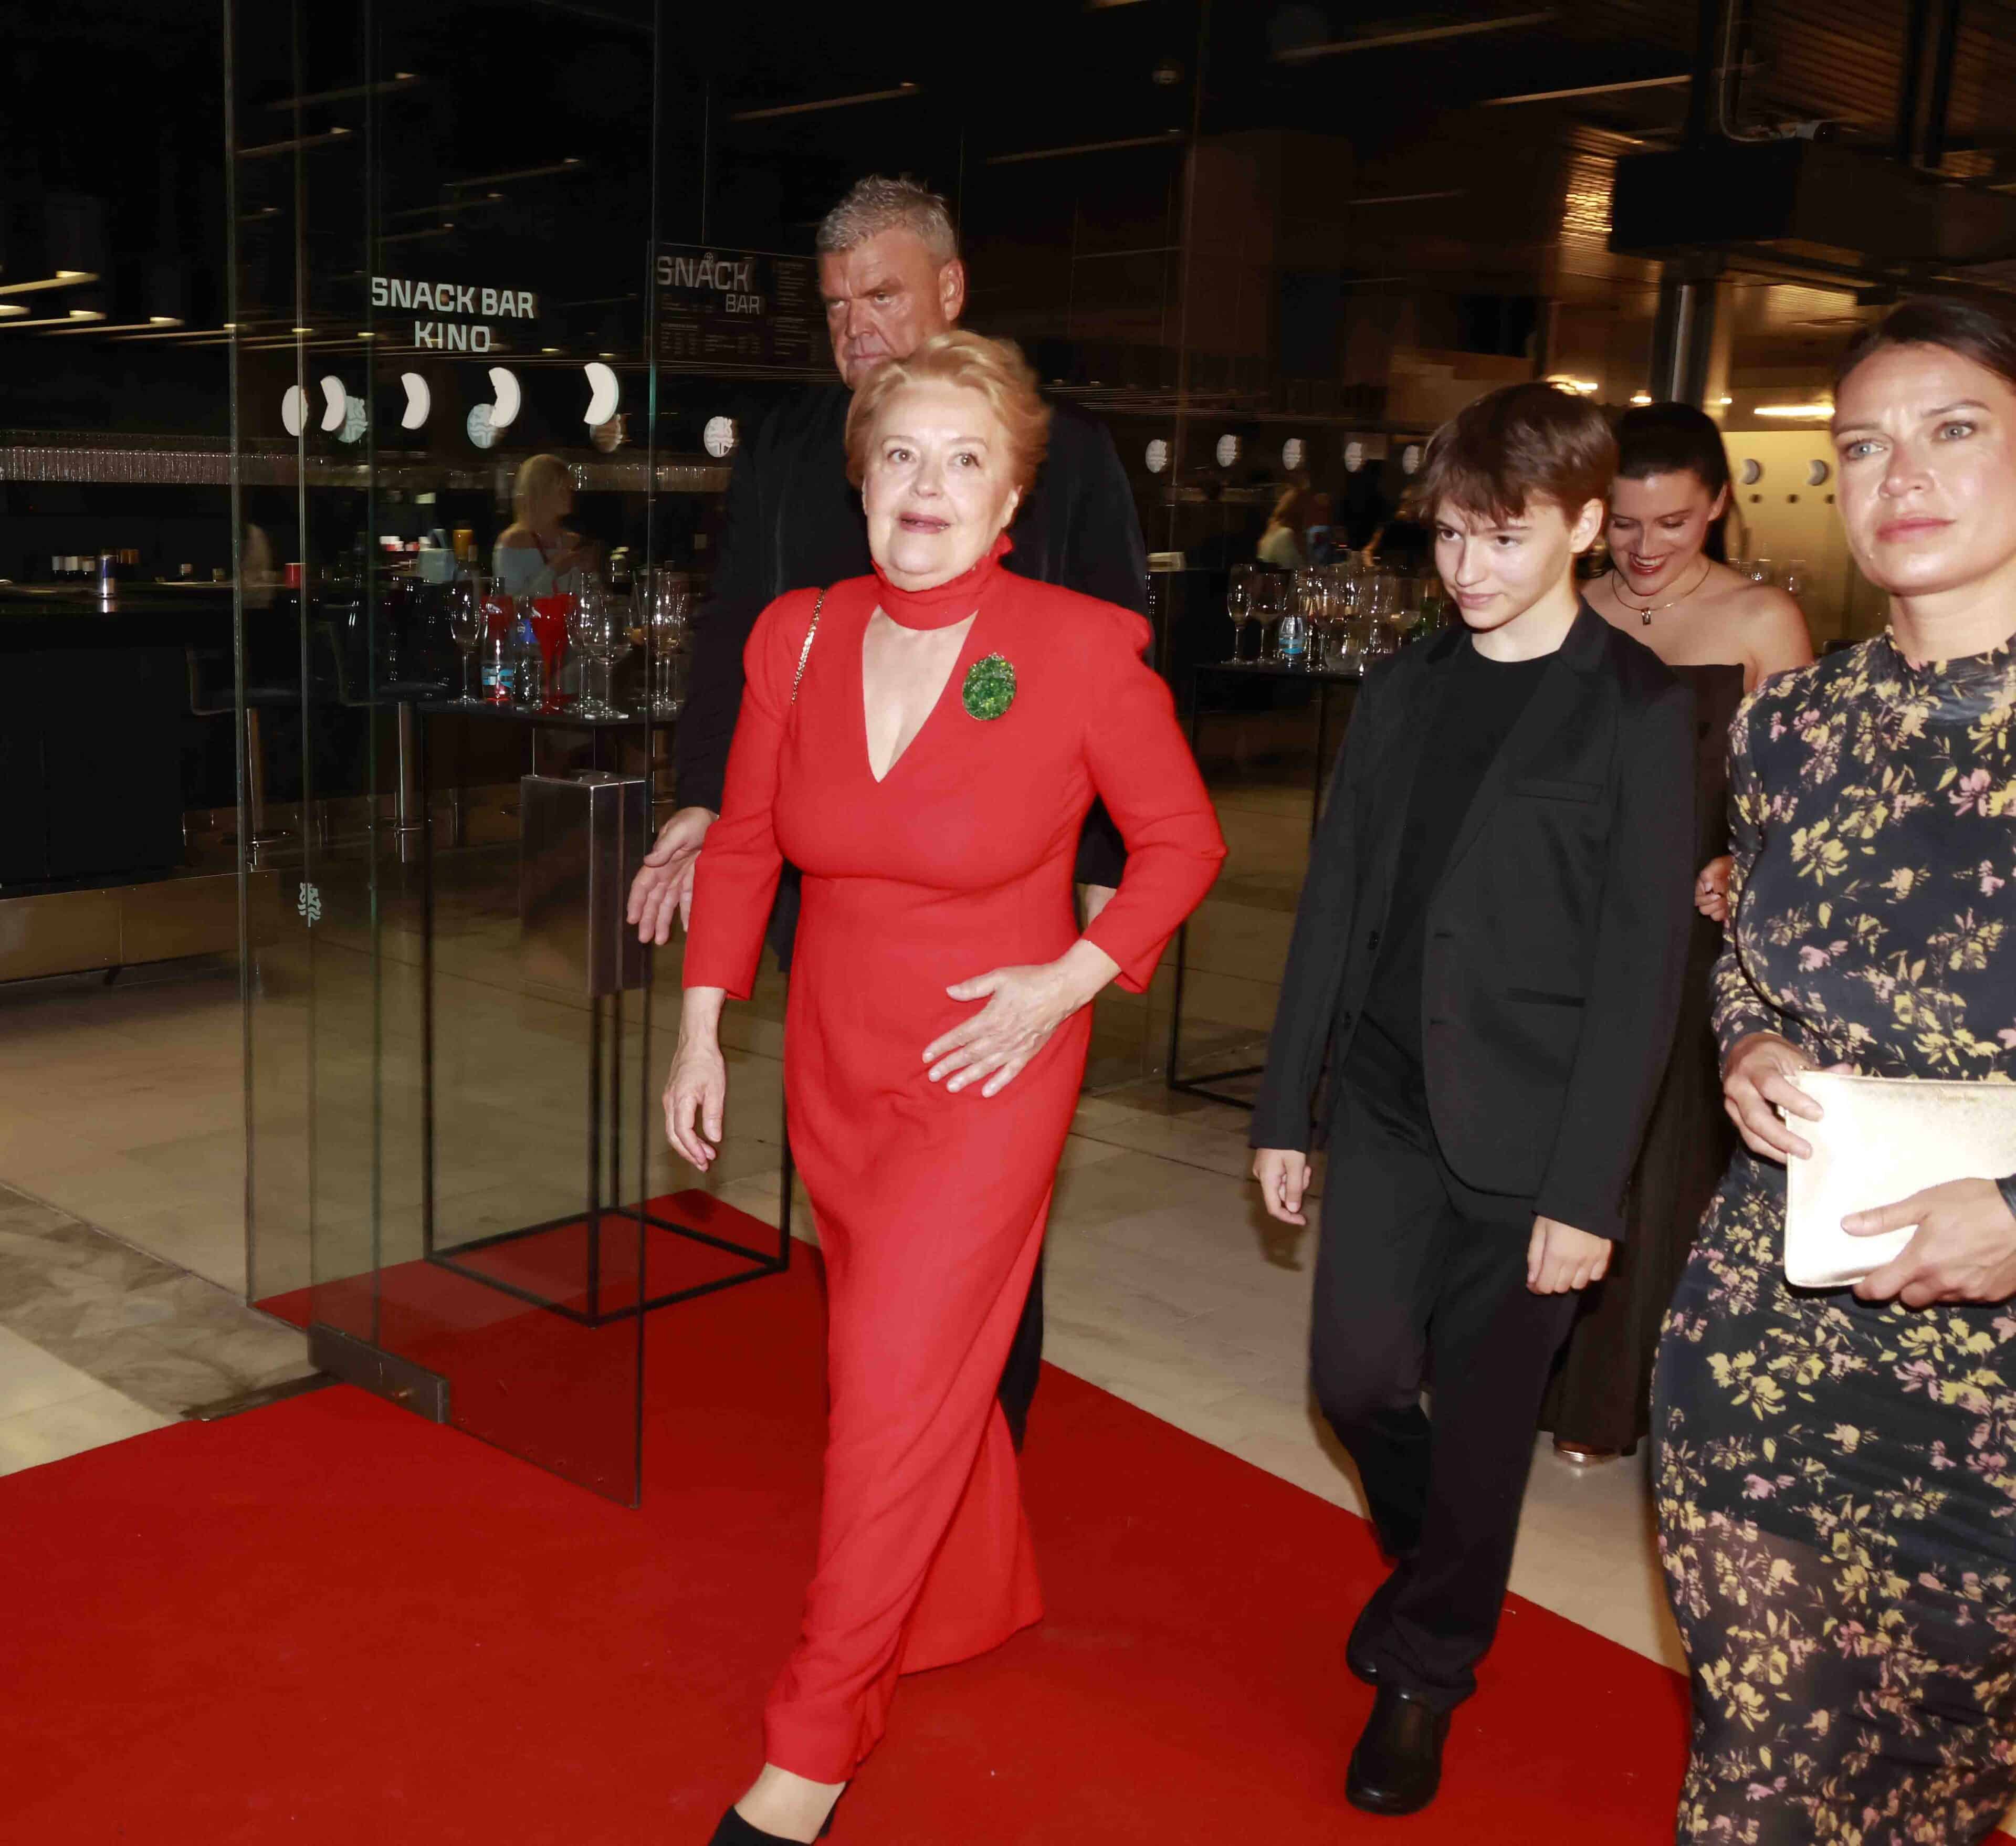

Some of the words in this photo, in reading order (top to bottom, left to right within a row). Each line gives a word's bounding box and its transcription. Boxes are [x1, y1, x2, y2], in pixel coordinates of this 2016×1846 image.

[656, 256, 749, 292] SNACK
[371, 277, 475, 313] SNACK
[481, 288, 534, 319] BAR
[726, 293, 760, 315] BAR
[414, 321, 491, 352] KINO
